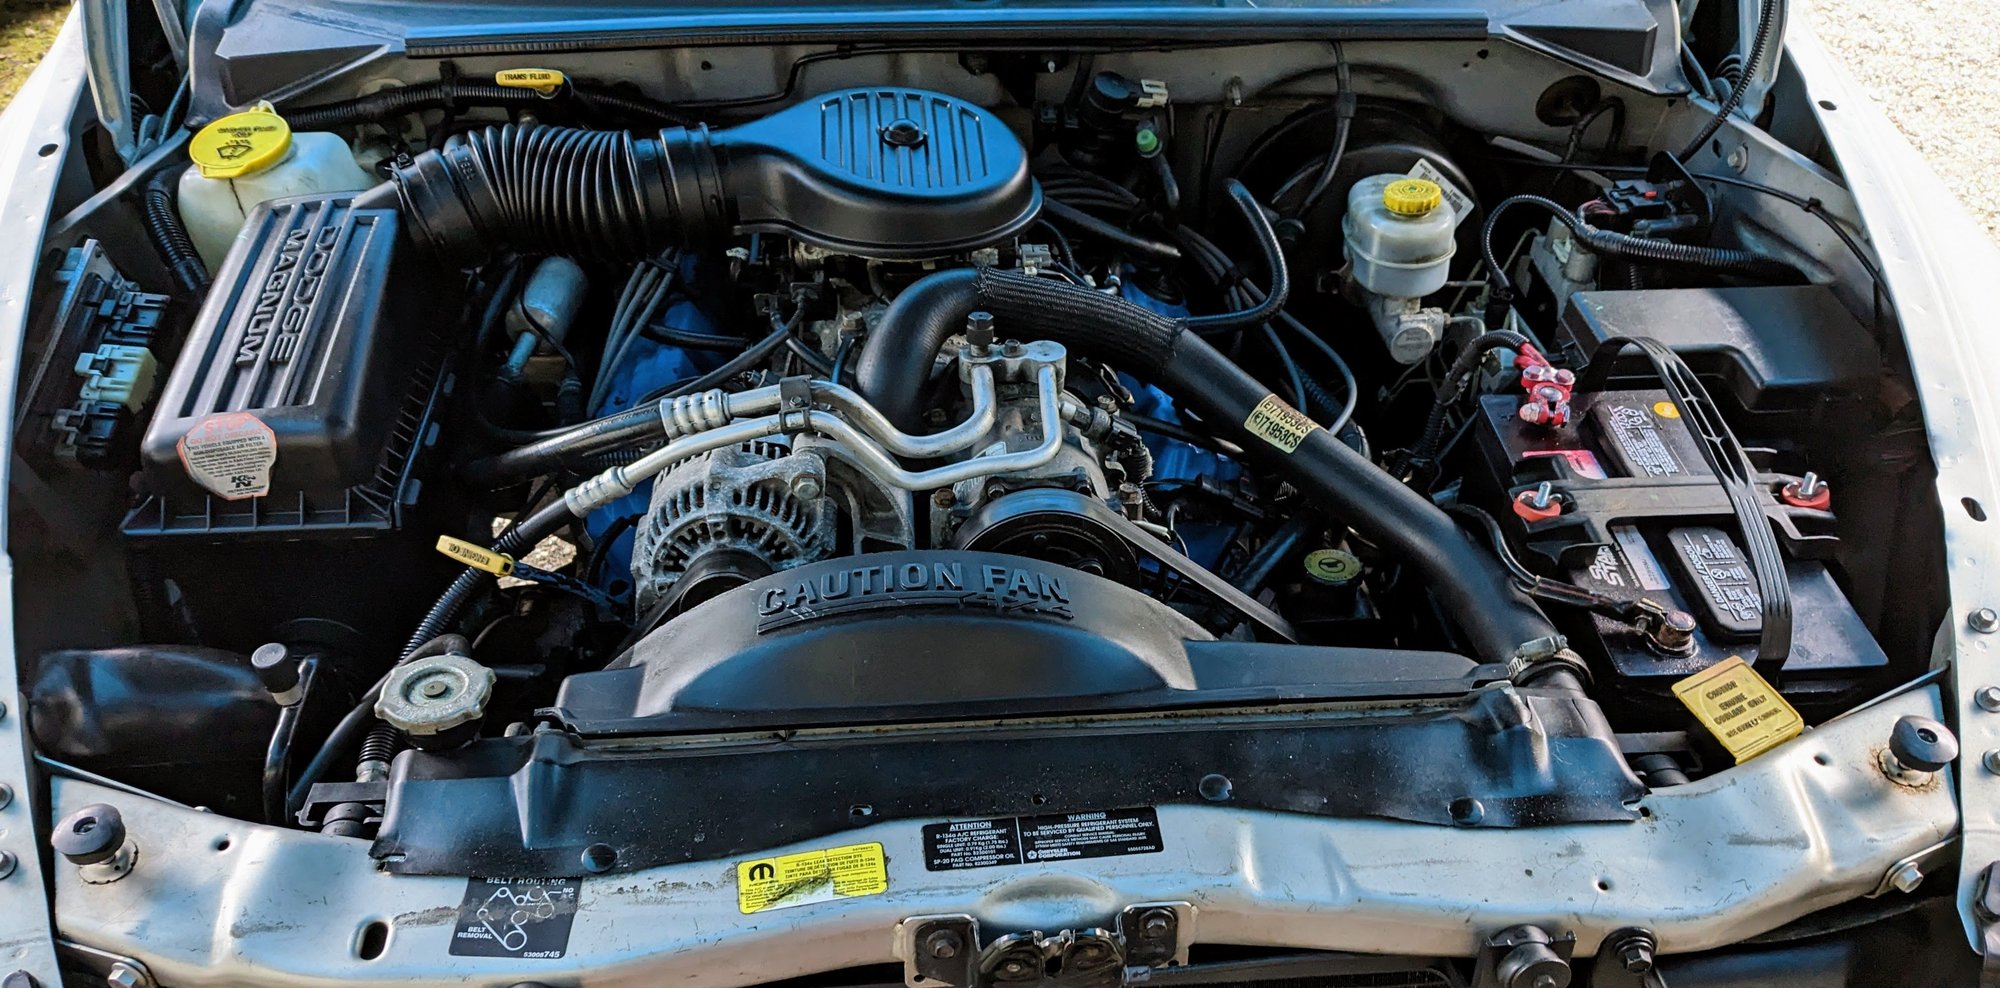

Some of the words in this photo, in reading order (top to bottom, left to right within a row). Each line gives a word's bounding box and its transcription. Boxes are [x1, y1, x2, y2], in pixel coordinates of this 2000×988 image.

[235, 228, 310, 366] MAGNUM
[270, 226, 342, 361] DODGE
[1249, 410, 1301, 448] (E)71953CS
[757, 561, 964, 617] CAUTION
[982, 564, 1071, 604] FAN
[1067, 812, 1106, 822] WARNING
[949, 821, 992, 831] ATTENTION
[1038, 823, 1080, 831] HIGH-PRESSURE
[1081, 819, 1117, 827] REFRIGERANT
[1076, 825, 1104, 833] QUALIFIED
[970, 828, 1007, 836] REFRIGERANT
[826, 855, 852, 863] DETECTION
[965, 854, 1004, 862] COMPRESSOR
